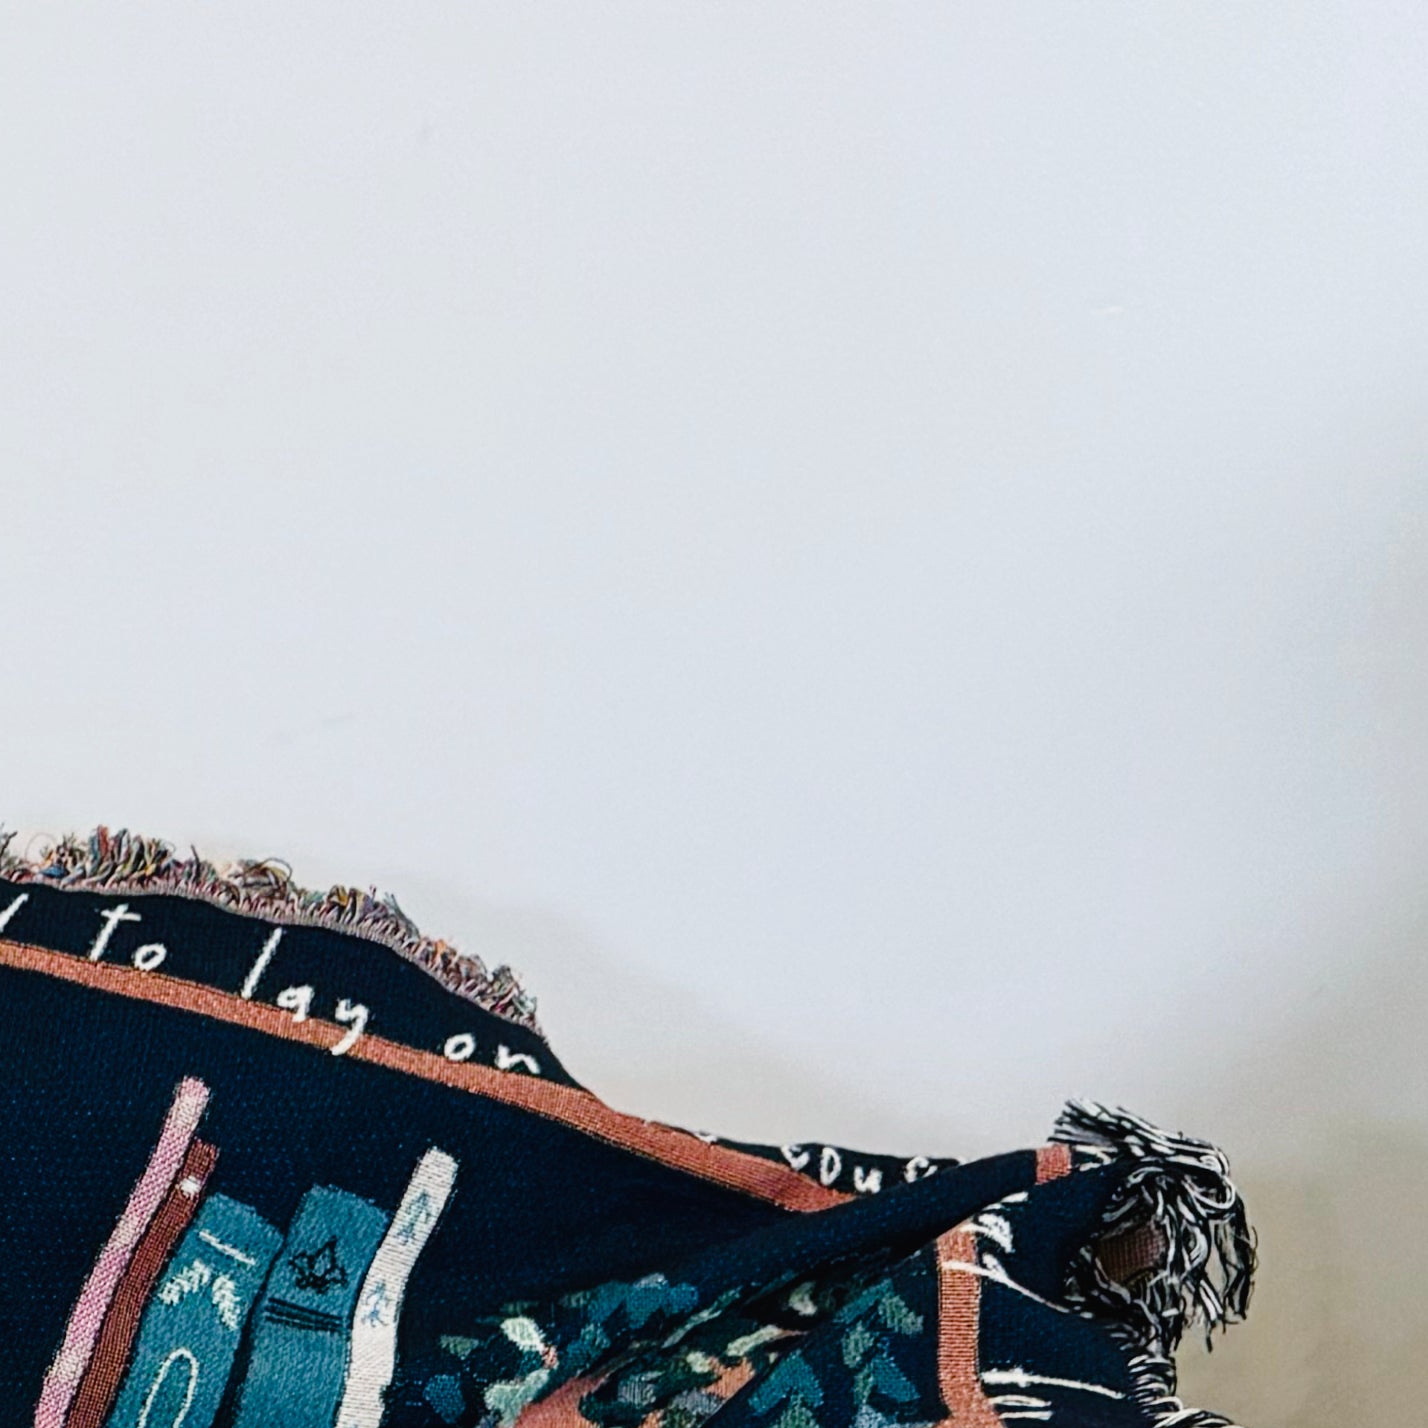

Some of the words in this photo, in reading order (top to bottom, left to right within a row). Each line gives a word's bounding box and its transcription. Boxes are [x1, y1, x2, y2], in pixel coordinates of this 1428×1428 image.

[89, 903, 167, 972] to
[241, 926, 370, 1057] lay
[443, 1031, 542, 1075] on
[780, 1144, 954, 1194] couc
